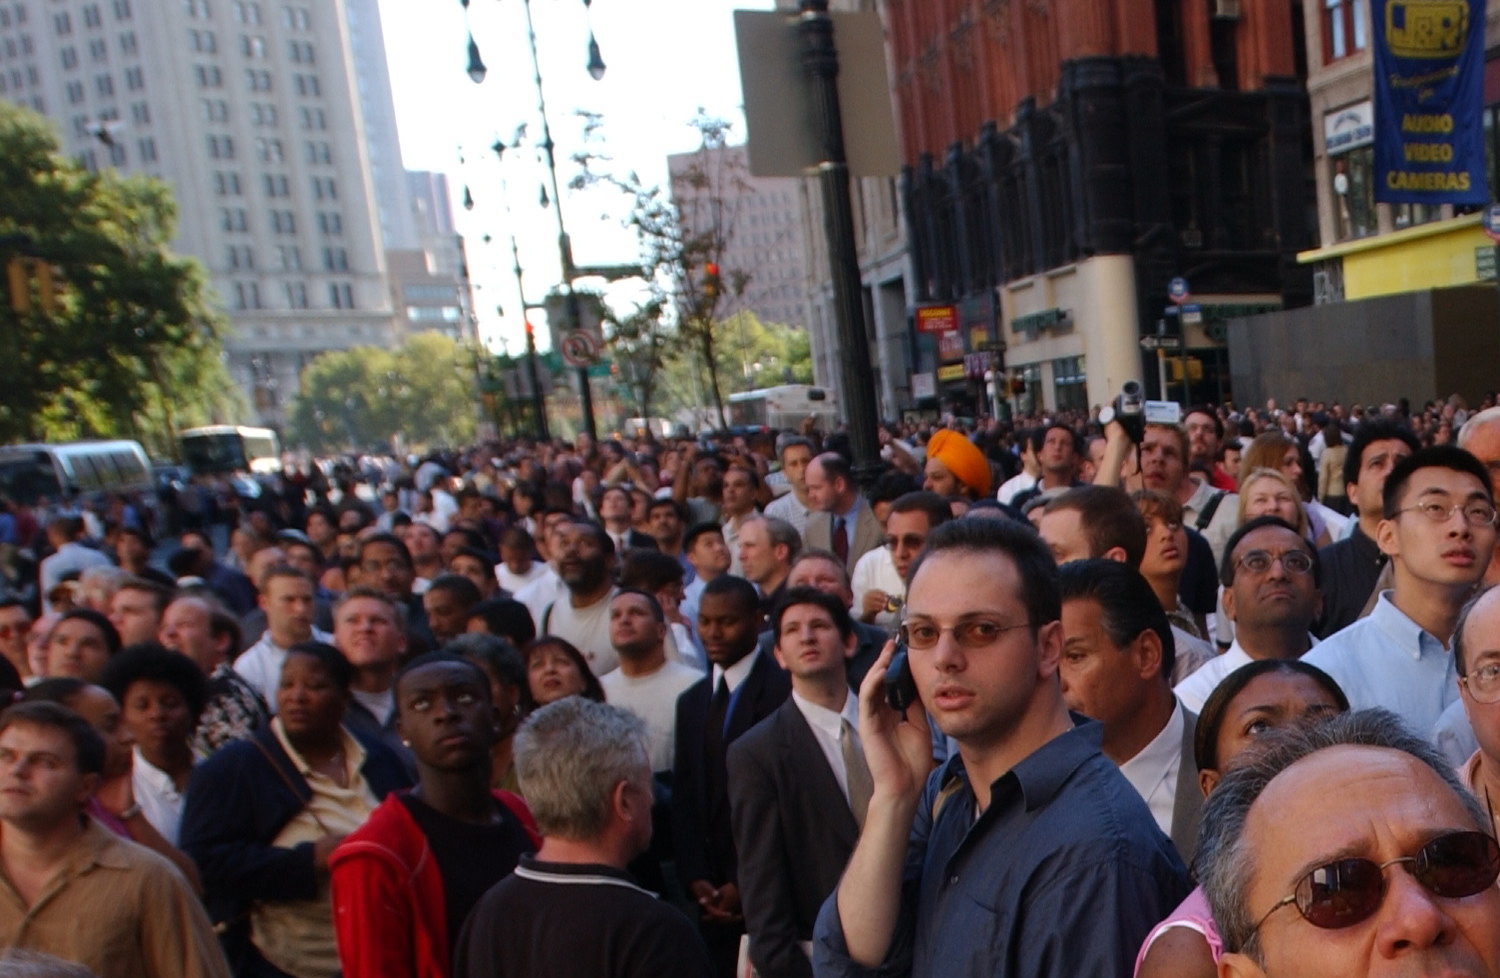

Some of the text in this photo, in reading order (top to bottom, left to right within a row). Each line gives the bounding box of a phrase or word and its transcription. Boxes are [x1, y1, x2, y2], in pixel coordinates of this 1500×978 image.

[1402, 113, 1454, 133] AUDIO
[1403, 143, 1453, 161] VIDEO
[1386, 171, 1470, 190] CAMERAS
